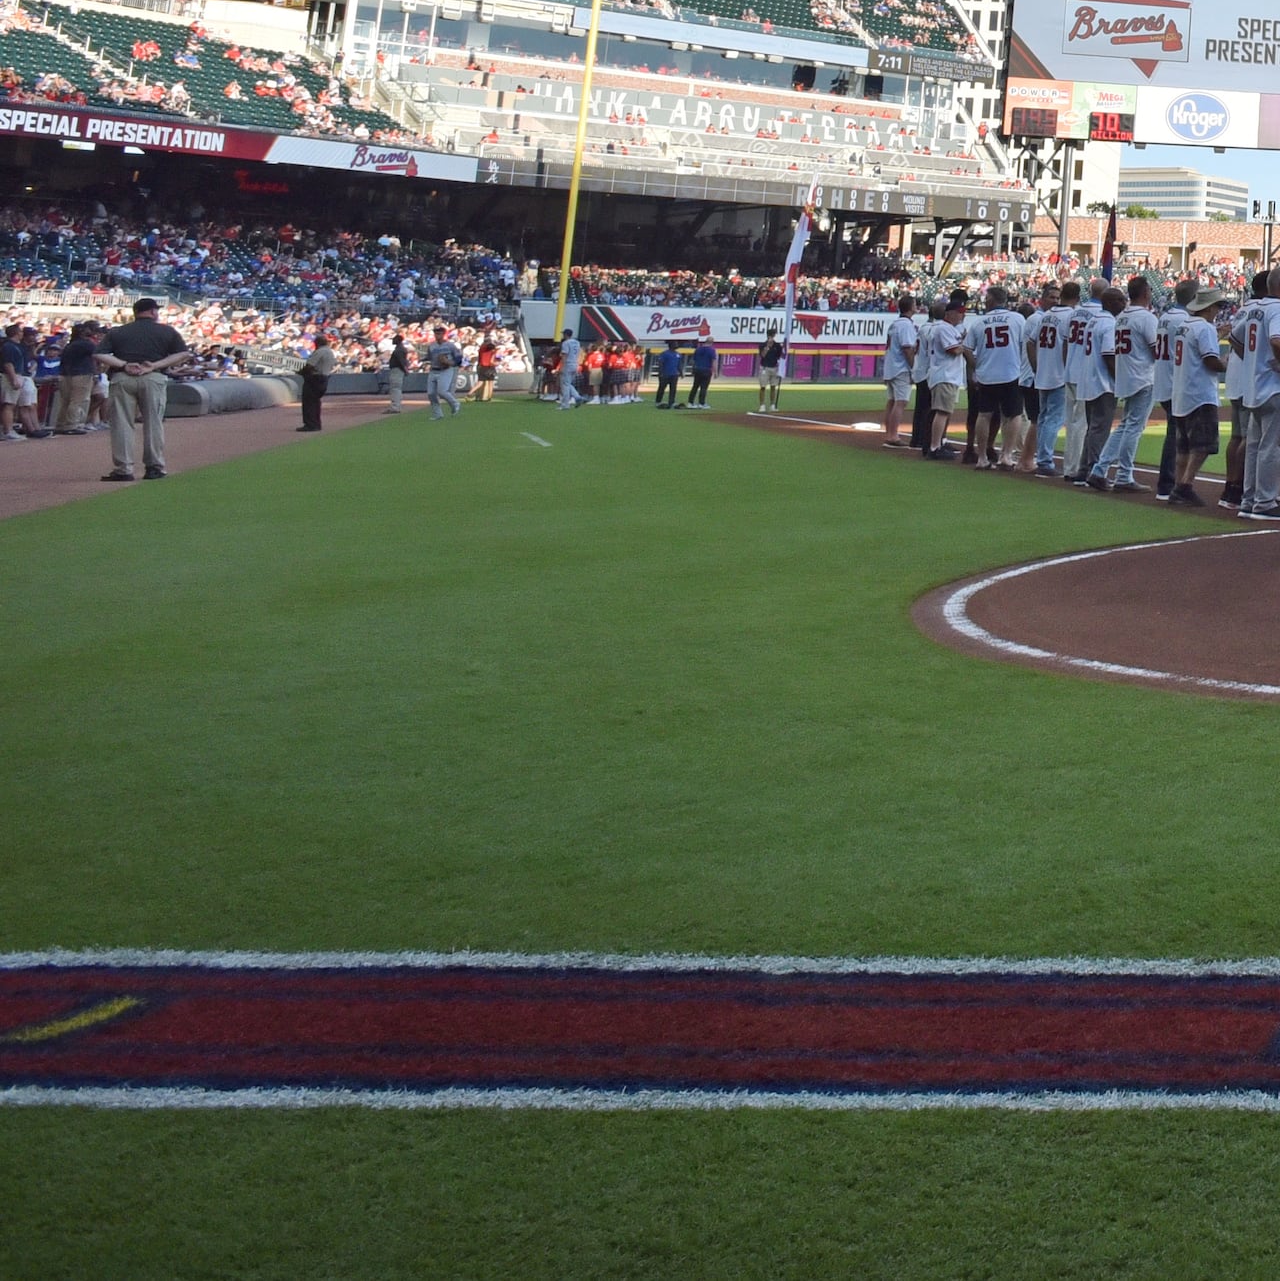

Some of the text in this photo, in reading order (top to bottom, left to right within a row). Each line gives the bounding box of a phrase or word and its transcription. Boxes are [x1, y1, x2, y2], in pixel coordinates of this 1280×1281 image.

[1069, 6, 1165, 41] Braves
[878, 55, 902, 69] 7:11
[1173, 99, 1226, 136] Kroger
[0, 109, 226, 153] SPECIAL PRESENTATION
[1091, 131, 1132, 140] MILLION
[350, 146, 409, 169] Braves
[831, 189, 875, 210] H E
[903, 196, 925, 205] MOUND
[905, 205, 924, 215] VISITS
[647, 312, 702, 334] Braves
[731, 317, 784, 334] SPECIAL
[984, 325, 1009, 349] 15
[1039, 325, 1057, 349] 43
[1249, 323, 1257, 352] 6
